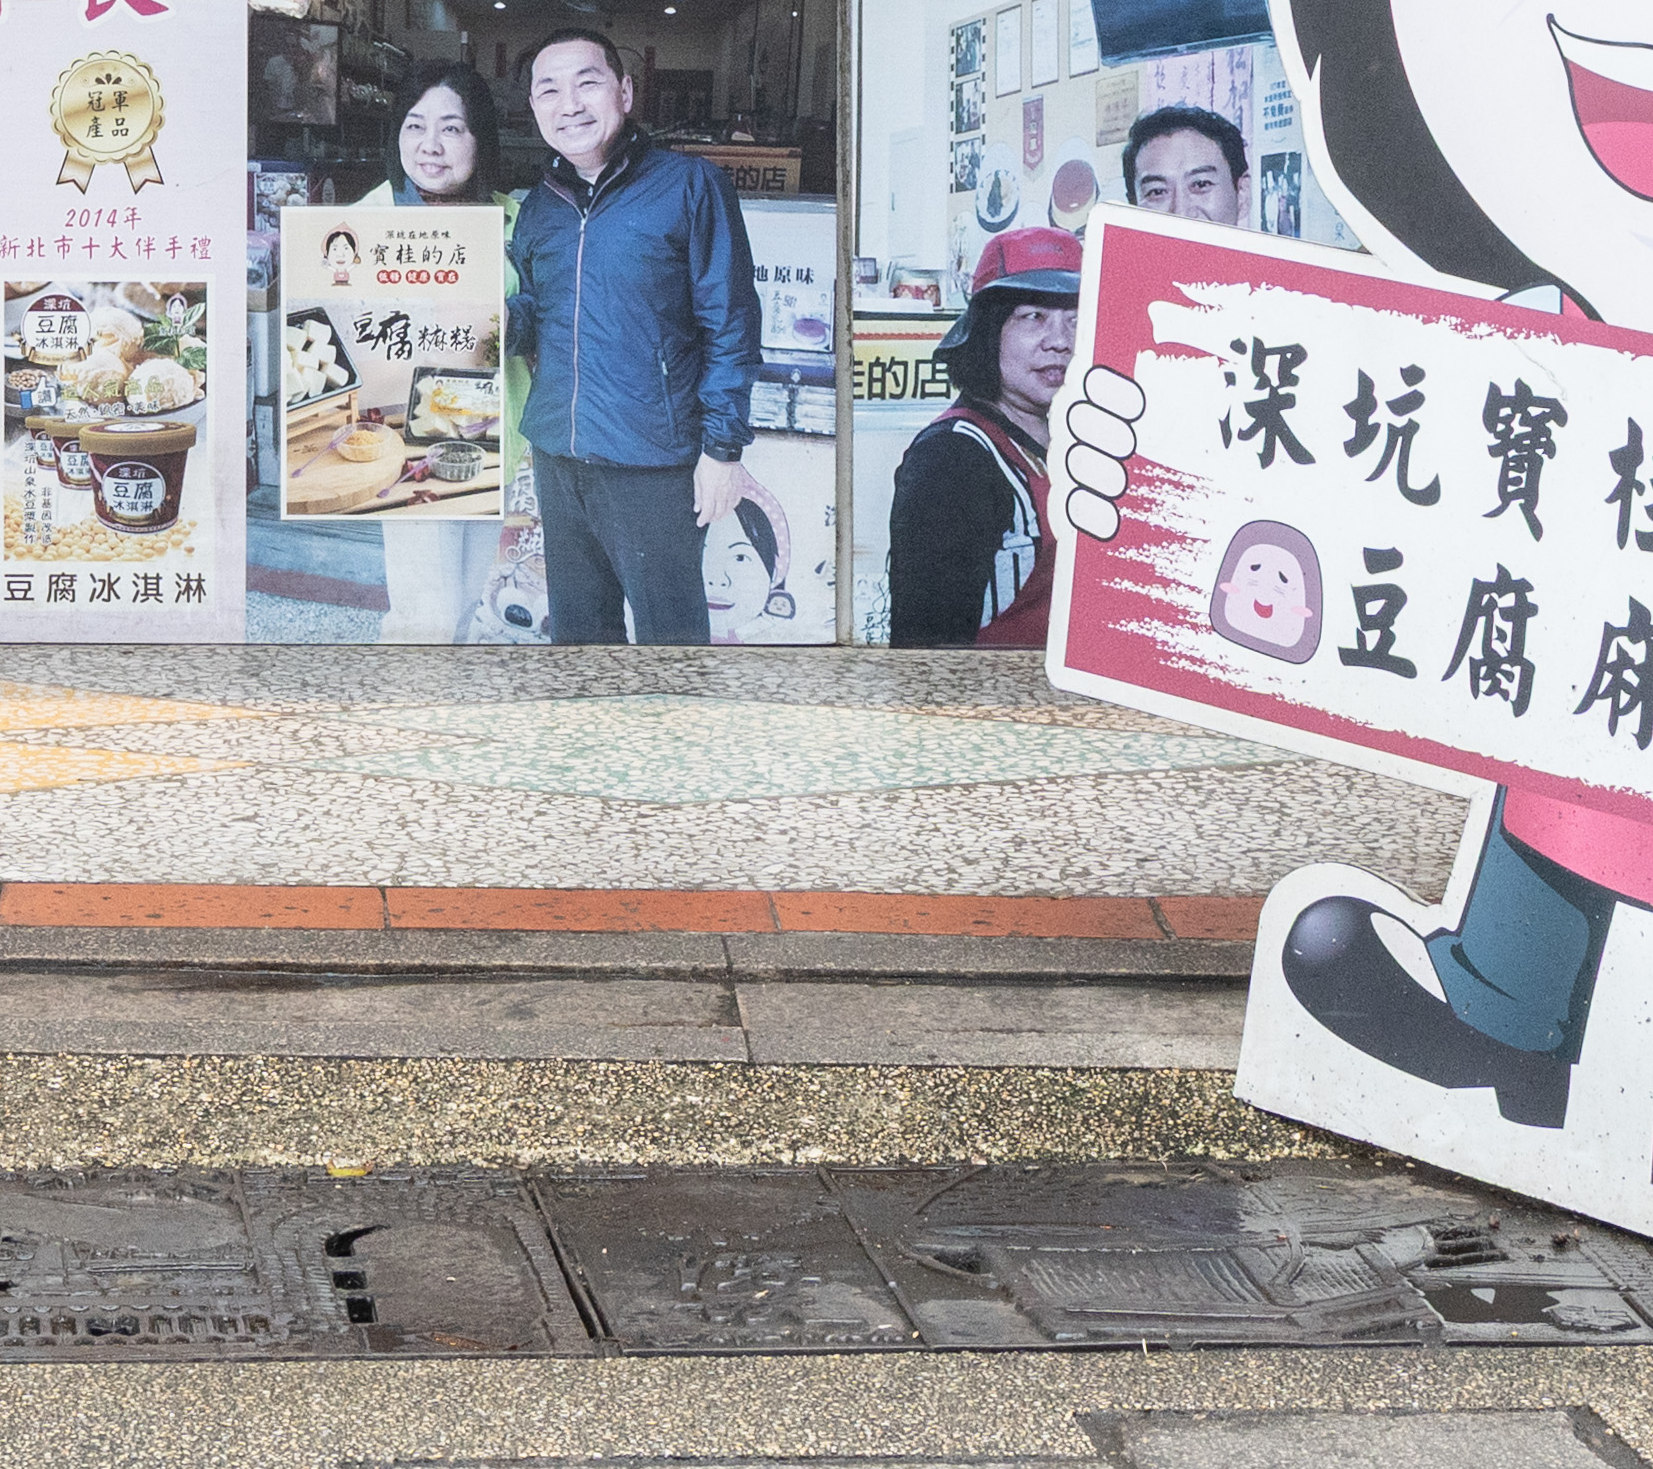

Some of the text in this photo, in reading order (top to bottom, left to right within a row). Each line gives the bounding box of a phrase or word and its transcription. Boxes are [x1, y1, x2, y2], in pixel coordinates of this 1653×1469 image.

[86, 90, 130, 114] 冠軍
[86, 116, 130, 139] 產品
[64, 206, 144, 231] 2014年
[369, 243, 468, 267] 寶桂的店
[43, 298, 72, 311] 深坑
[35, 314, 79, 336] 豆腐
[35, 336, 80, 350] 冰淇淋
[112, 482, 154, 501] 豆腐
[3, 572, 207, 605] 豆腐冰淇淋
